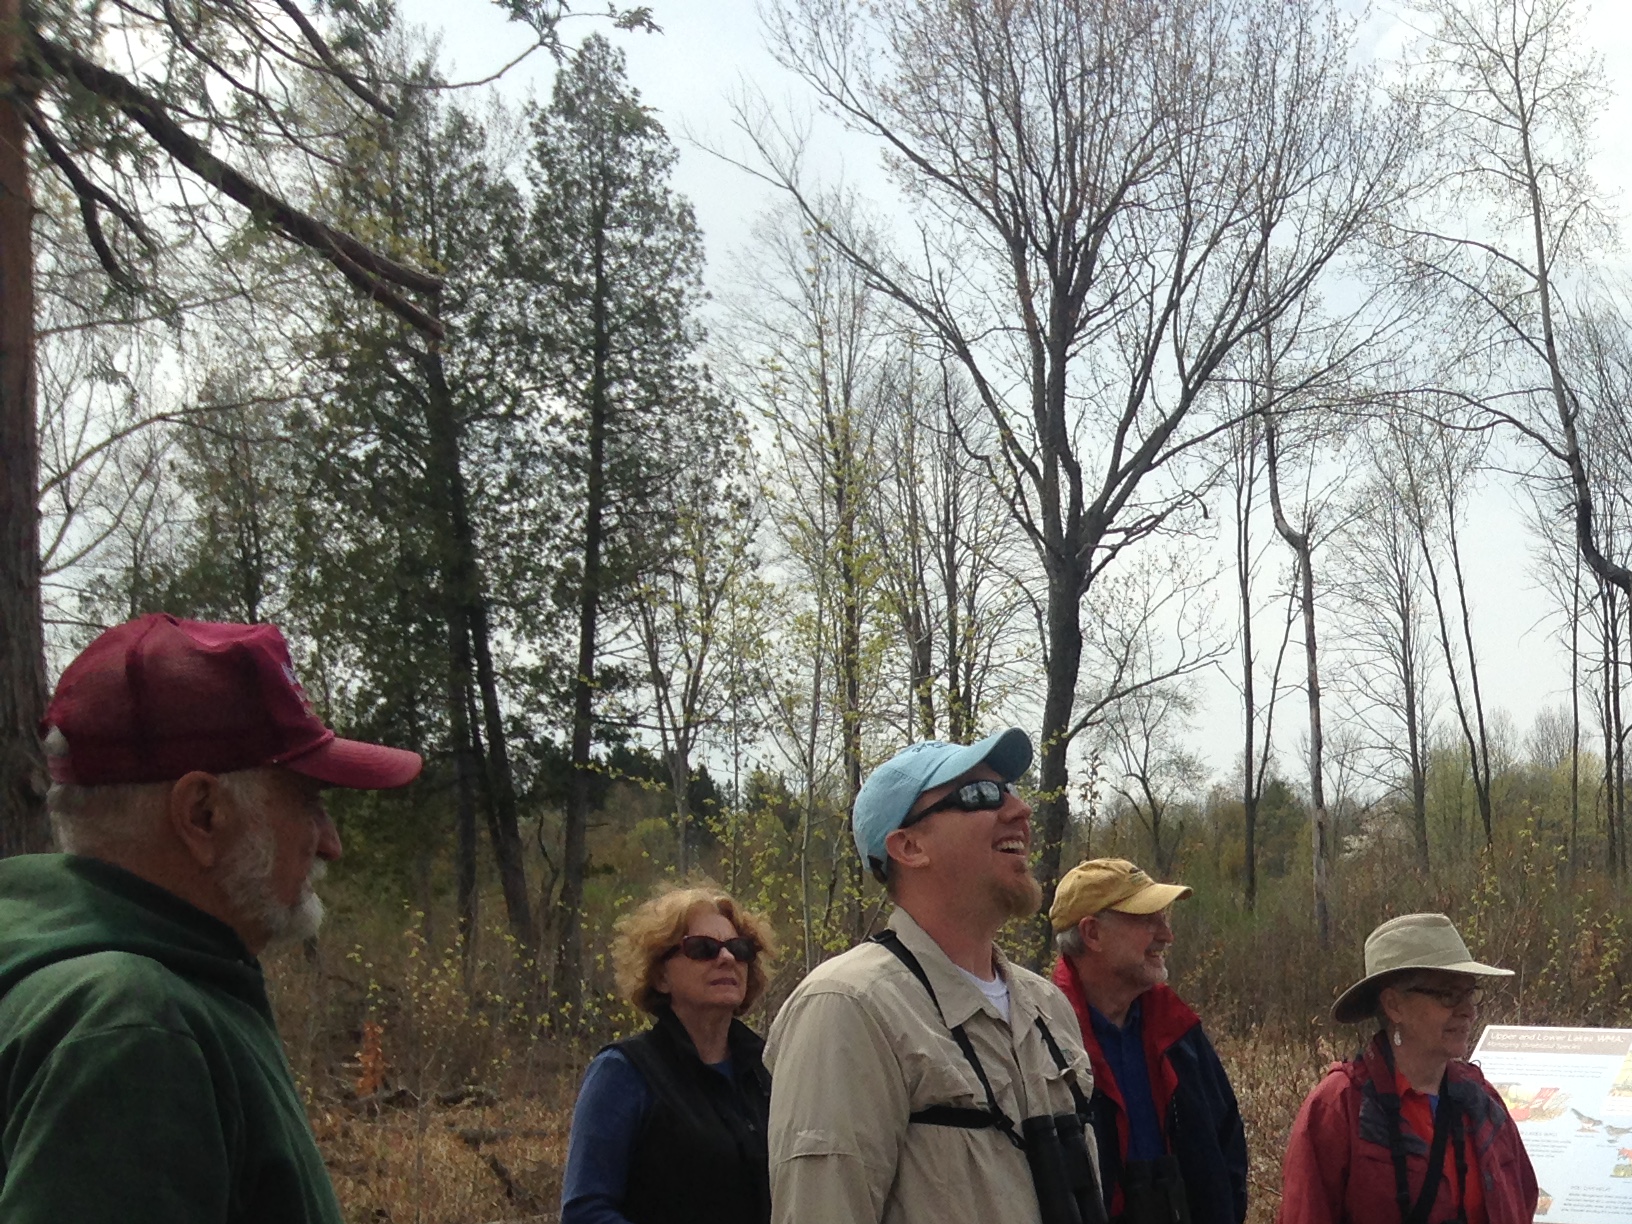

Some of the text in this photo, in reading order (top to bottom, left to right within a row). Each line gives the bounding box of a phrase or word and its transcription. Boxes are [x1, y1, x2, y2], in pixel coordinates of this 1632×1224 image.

[1490, 1032, 1516, 1041] Upper
[1518, 1033, 1536, 1041] and
[1537, 1033, 1565, 1041] Lower
